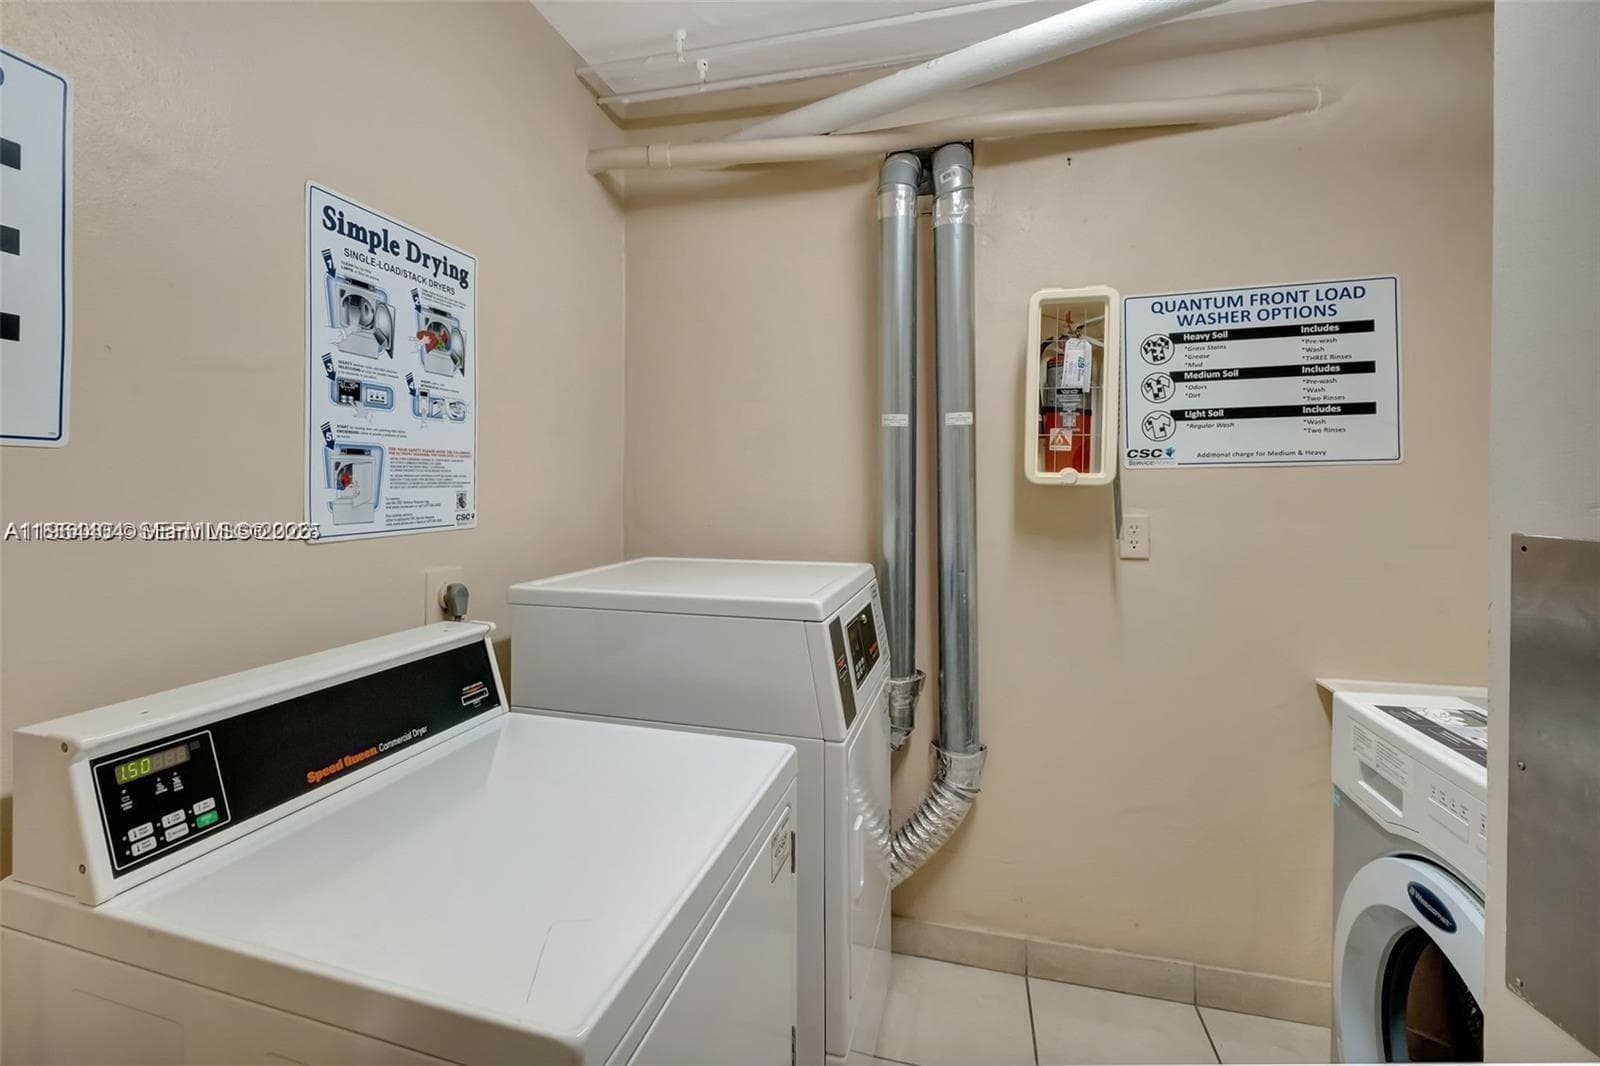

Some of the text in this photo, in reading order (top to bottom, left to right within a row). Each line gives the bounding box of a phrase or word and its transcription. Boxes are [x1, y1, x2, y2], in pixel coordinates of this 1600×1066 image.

[322, 205, 469, 289] Simple Drying
[344, 247, 427, 285] SINGLE-LOAD/STACK
[428, 278, 456, 296] DRYERS
[1151, 286, 1366, 315] QUANTUM FRONT LOAD
[1177, 304, 1337, 326] WASHER OPTIONS
[1301, 324, 1339, 333] Includes
[1183, 330, 1228, 341] Heavy Soil
[326, 362, 333, 373] 3
[1301, 364, 1341, 374] Includes
[1184, 368, 1239, 380] Medium Soil
[1184, 409, 1225, 420] Light Soil
[1302, 405, 1342, 414] Includes
[326, 432, 333, 442] 5
[1127, 449, 1163, 459] CSC
[1232, 451, 1254, 459] charge
[1256, 449, 1266, 457] for
[1304, 449, 1327, 457] Heavy
[456, 513, 470, 521] CSC
[306, 726, 428, 784] Speed Queen Commercial Dryer
